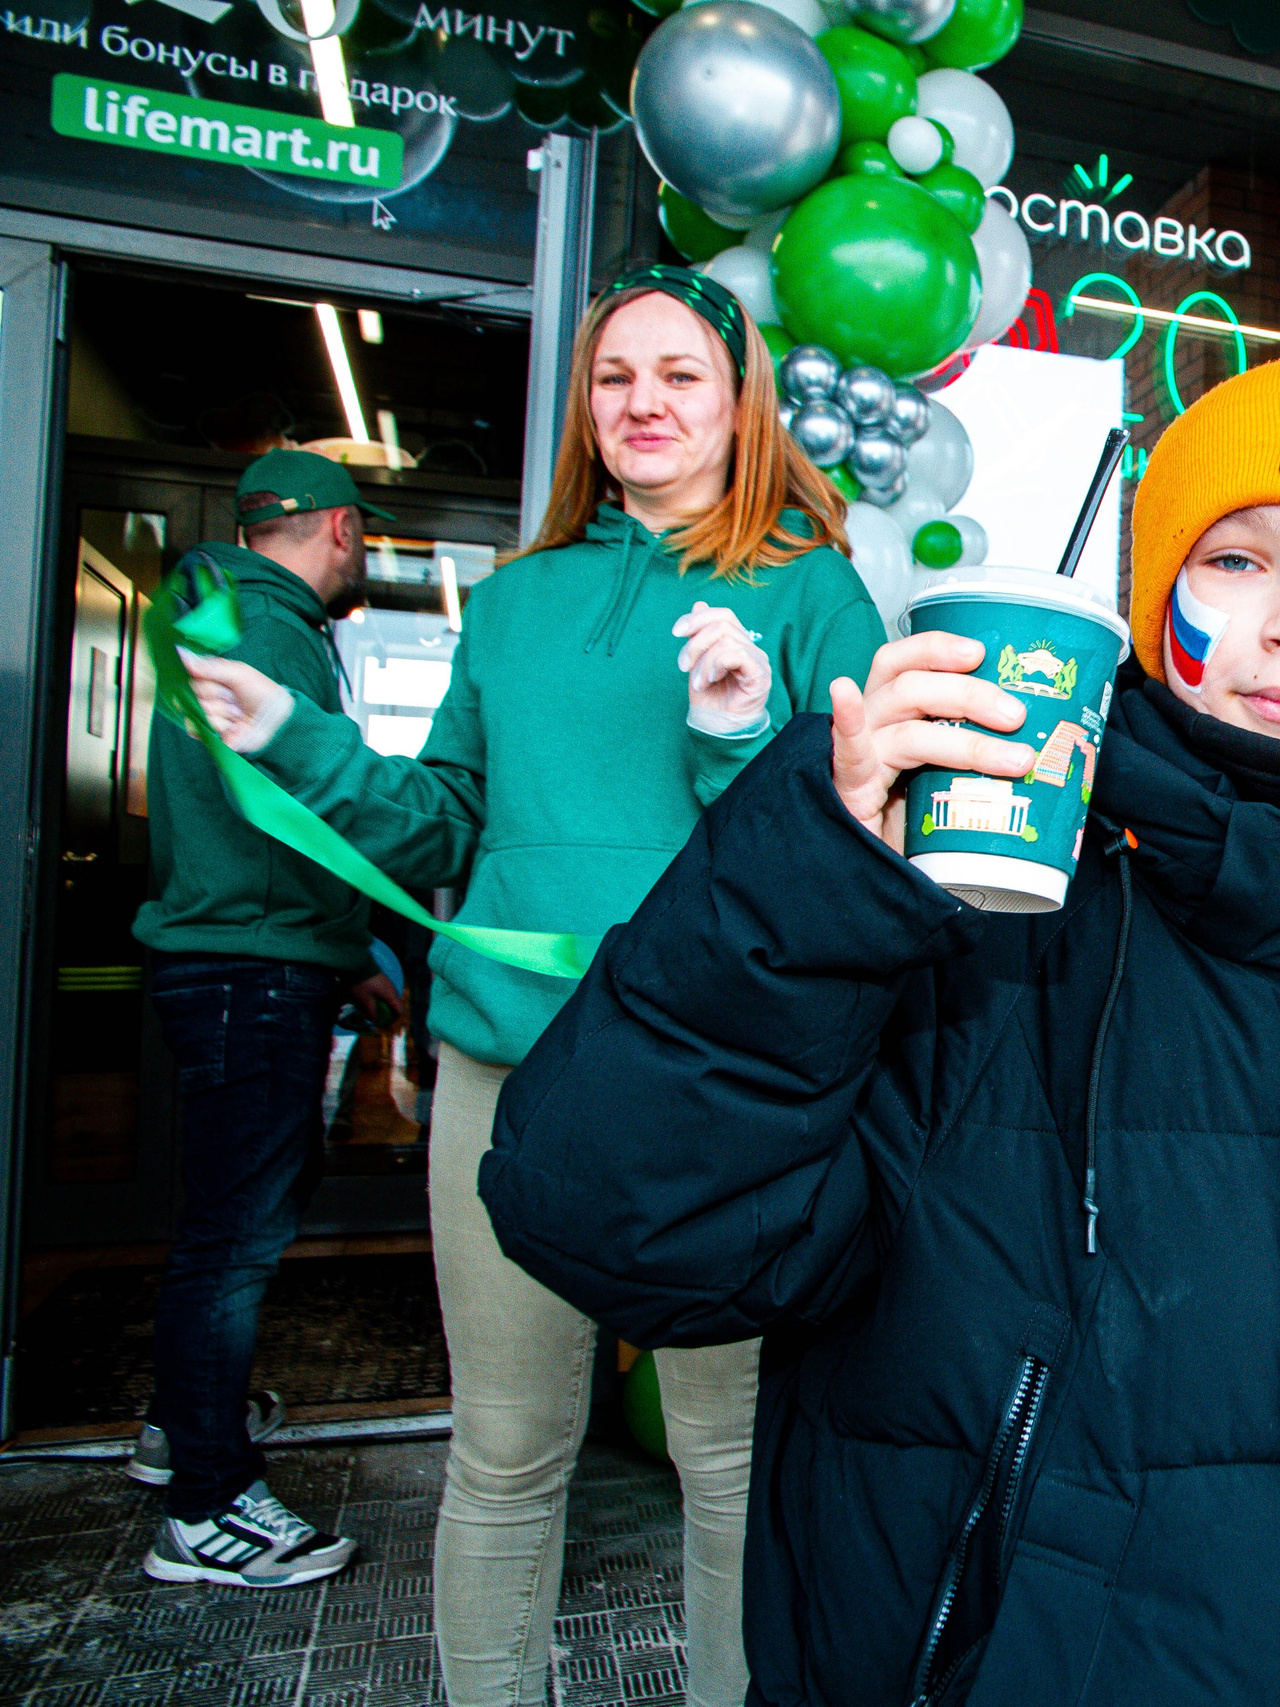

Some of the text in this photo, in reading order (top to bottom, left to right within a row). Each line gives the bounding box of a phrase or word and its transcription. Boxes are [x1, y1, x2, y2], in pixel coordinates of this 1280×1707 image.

[4, 9, 88, 49] или
[101, 25, 259, 81] бонусы
[268, 63, 288, 87] в
[299, 69, 457, 117] пдарок
[413, 3, 575, 60] минут
[83, 86, 381, 179] lifemart.ru
[983, 185, 1251, 270] оставка
